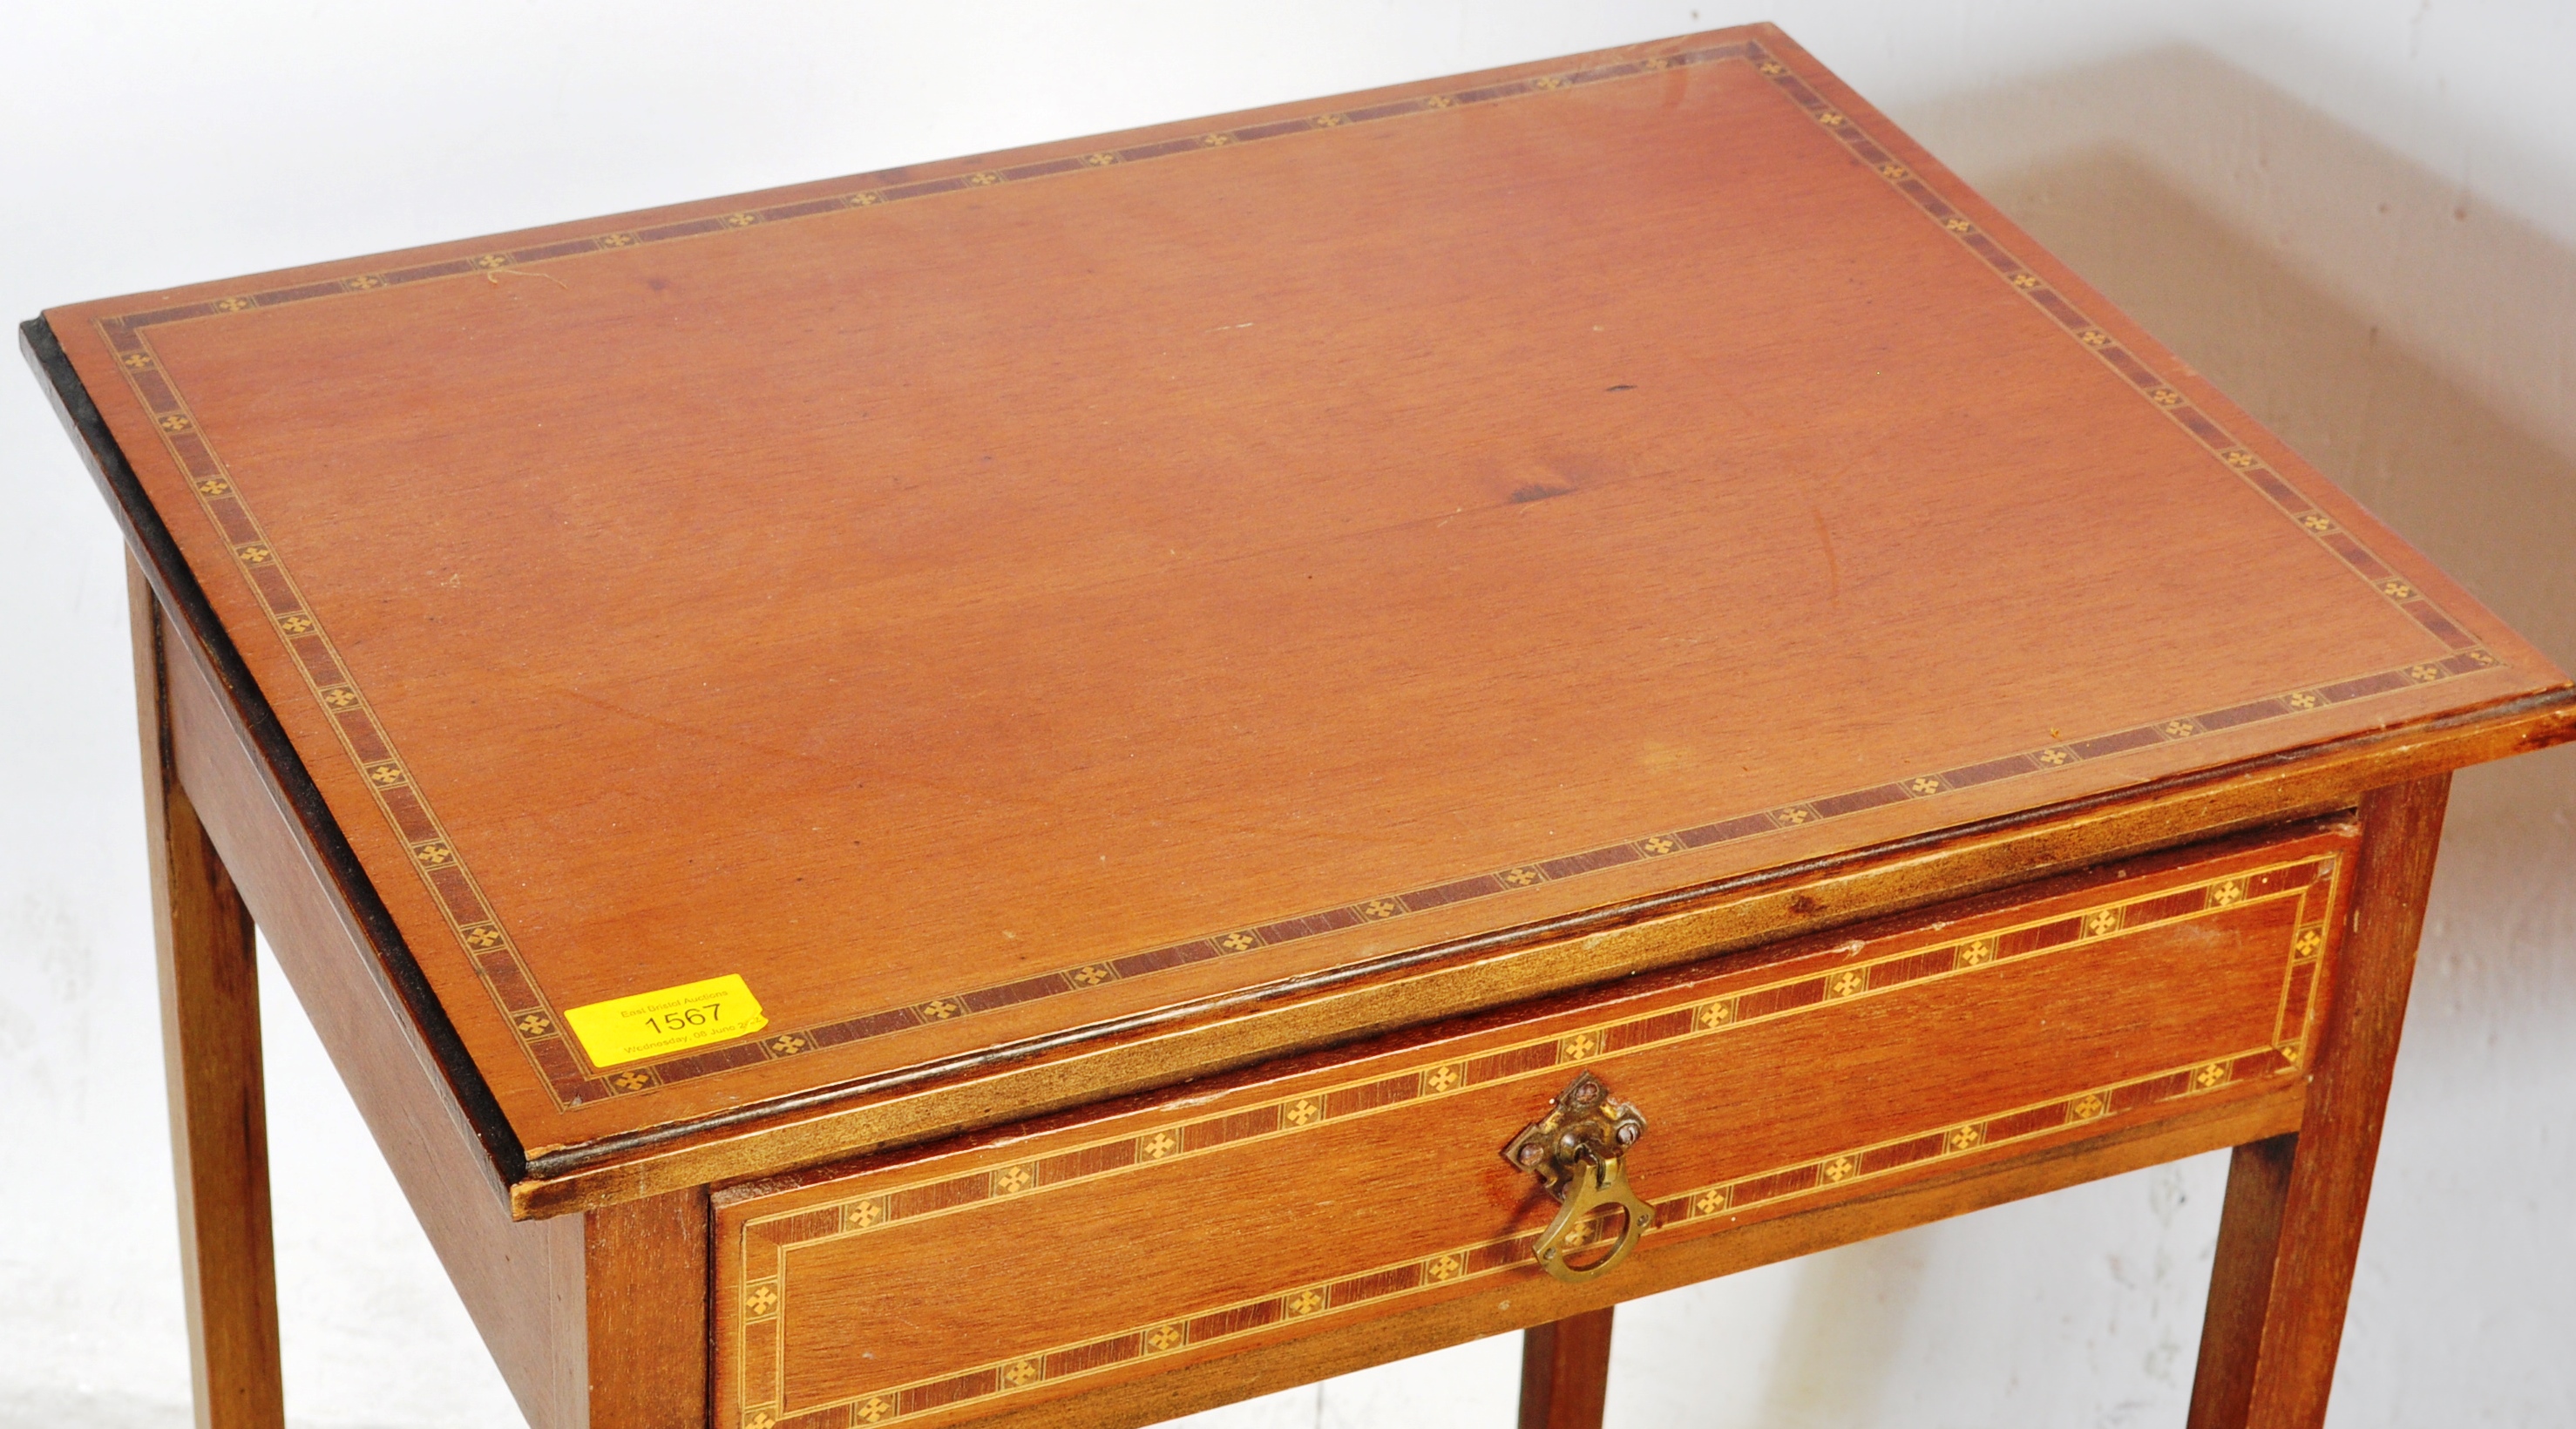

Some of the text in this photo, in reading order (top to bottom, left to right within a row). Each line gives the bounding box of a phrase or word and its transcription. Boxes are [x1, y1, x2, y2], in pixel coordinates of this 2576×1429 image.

[620, 991, 729, 1018] East Bristol Auctions
[645, 1003, 721, 1034] 1567
[624, 1035, 692, 1053] Wednesday,
[710, 1026, 736, 1035] June
